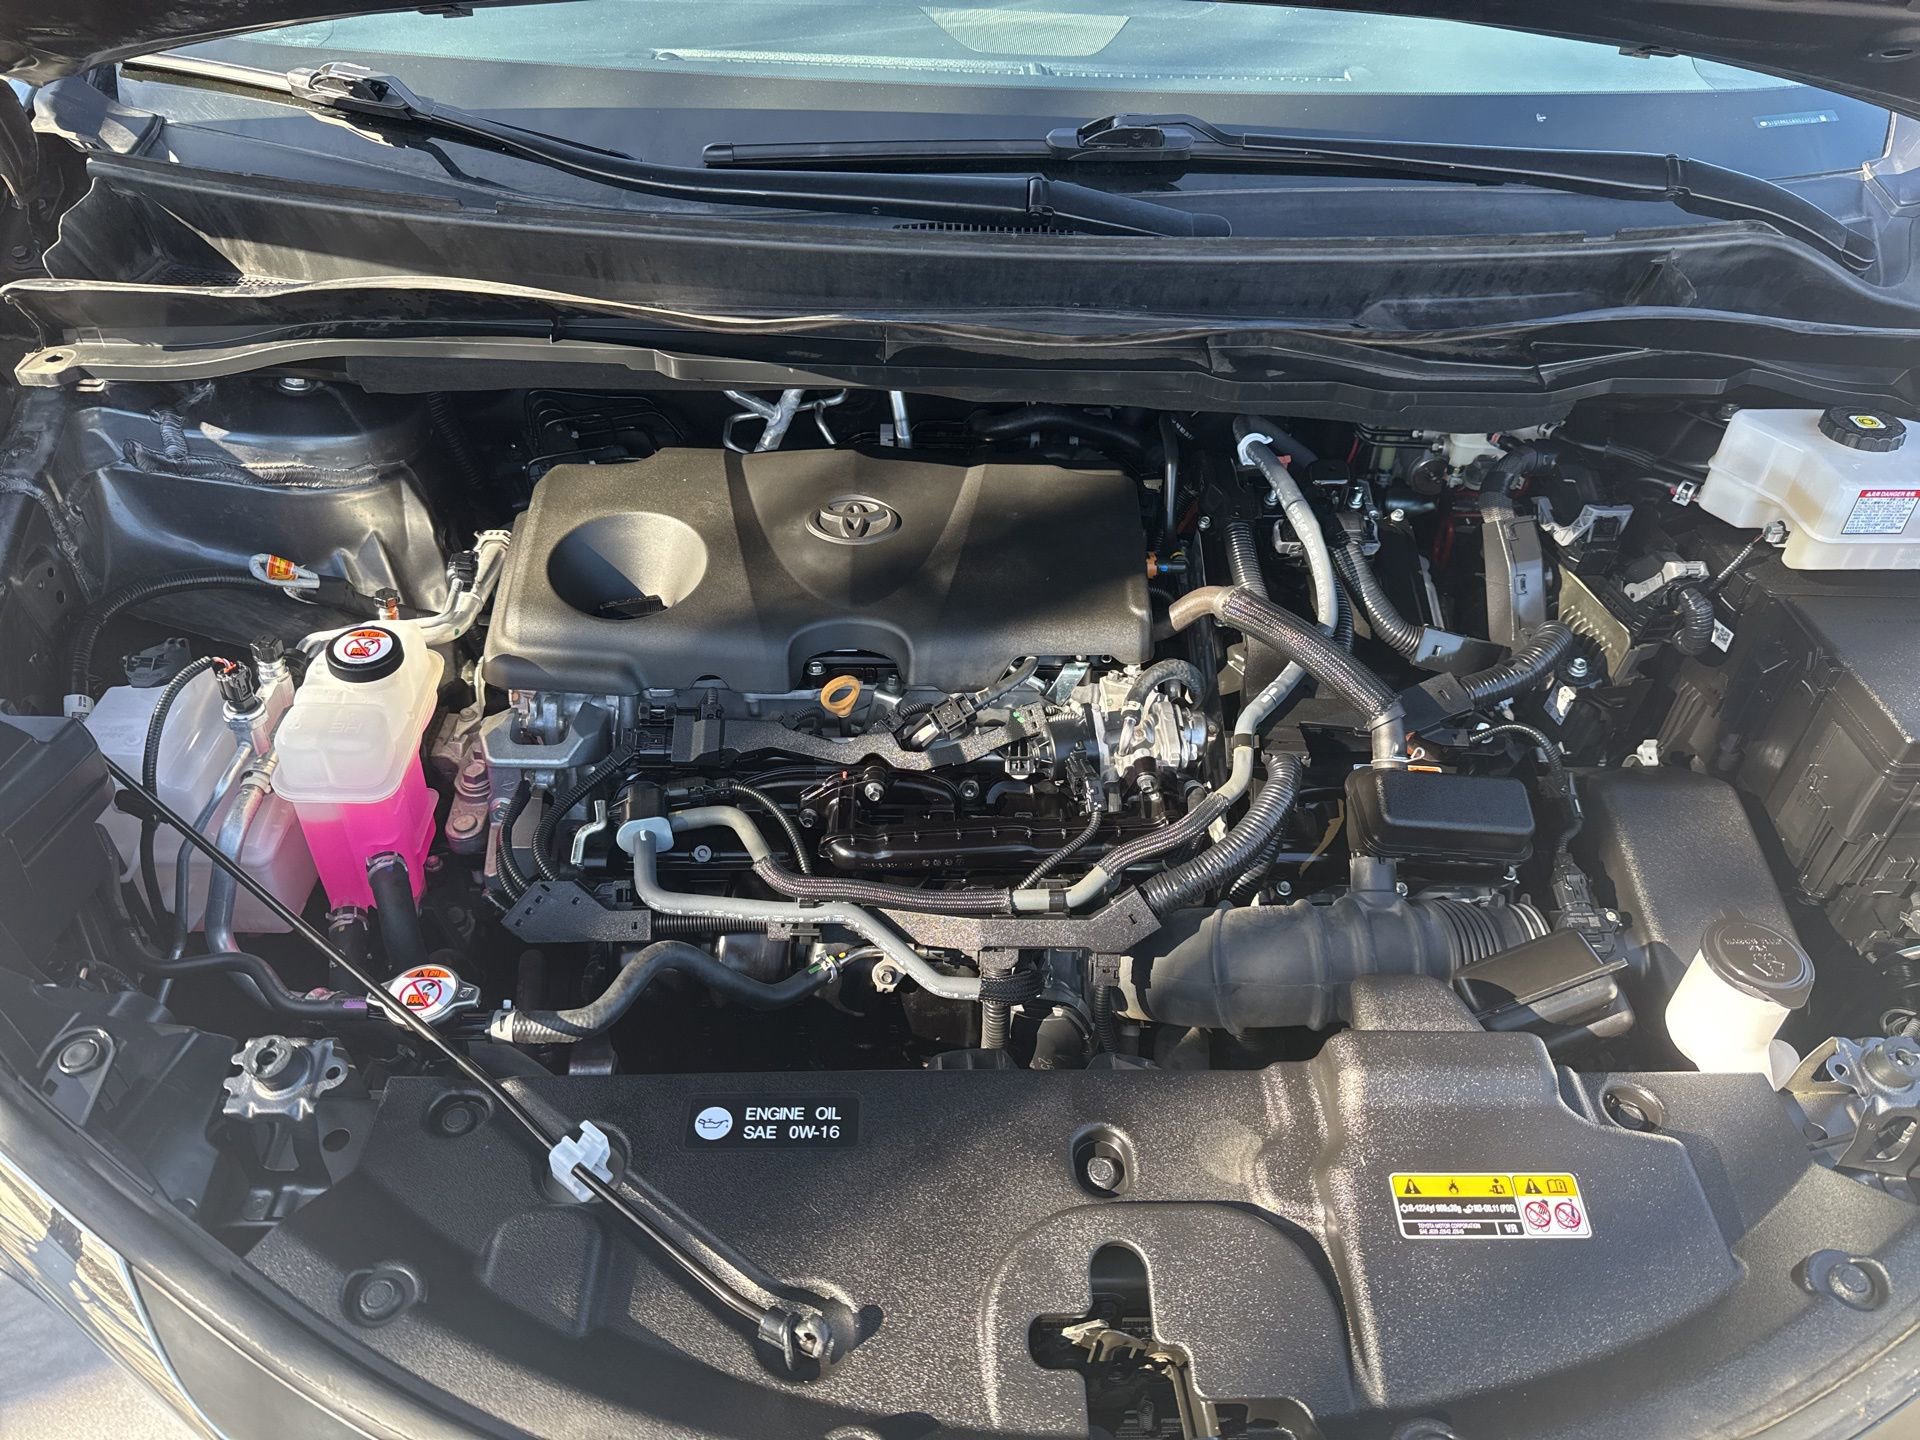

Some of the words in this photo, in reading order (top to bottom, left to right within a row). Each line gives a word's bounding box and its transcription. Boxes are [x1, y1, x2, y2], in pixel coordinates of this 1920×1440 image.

[745, 1107, 805, 1120] ENGINE
[815, 1107, 842, 1120] OIL
[743, 1125, 777, 1139] SAE
[789, 1125, 840, 1139] 0W-16
